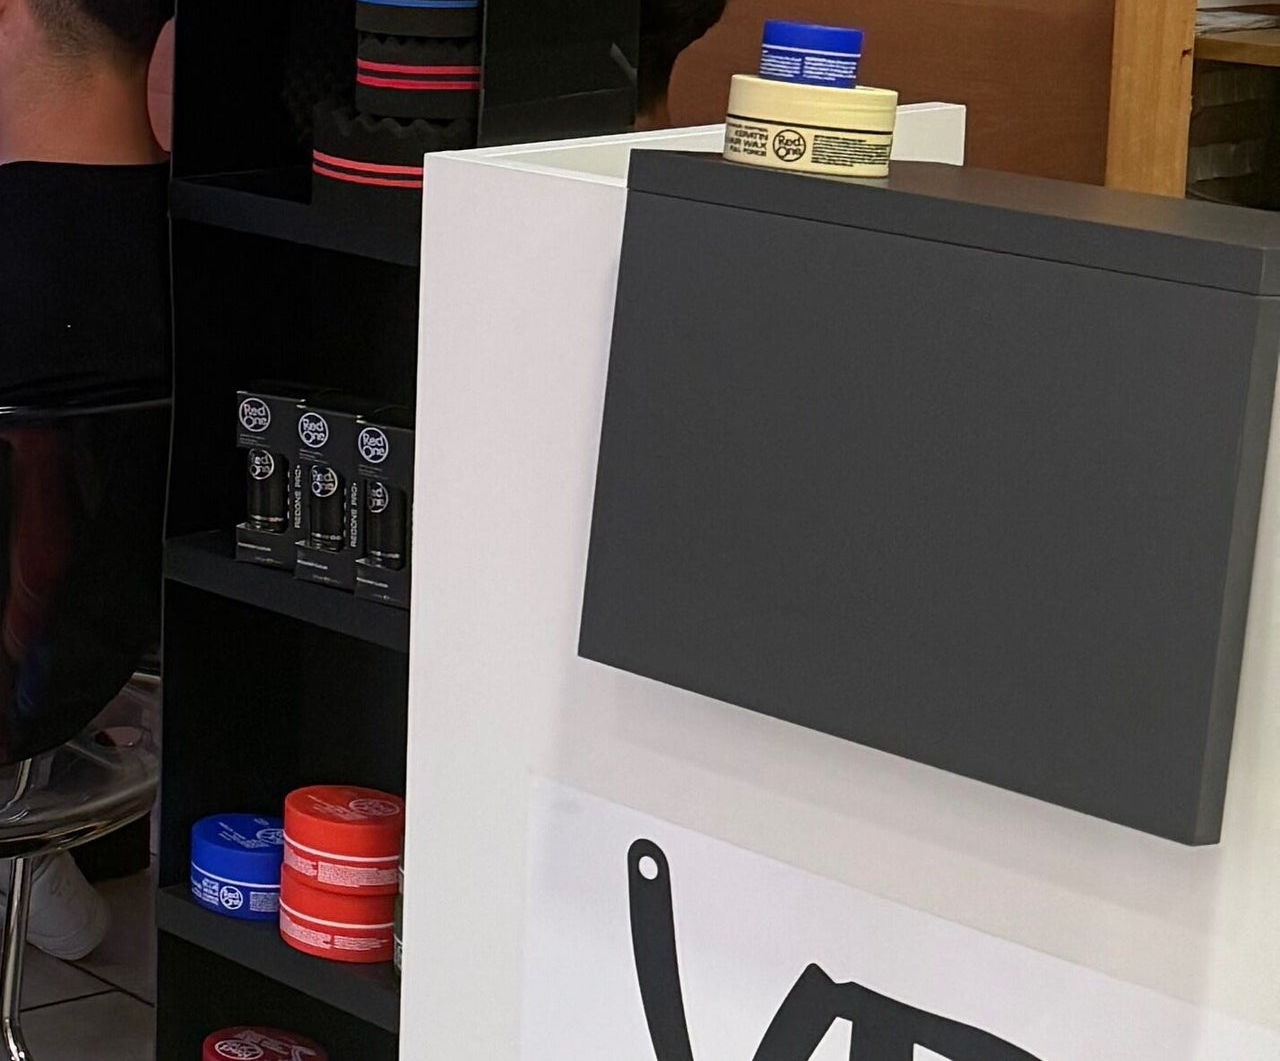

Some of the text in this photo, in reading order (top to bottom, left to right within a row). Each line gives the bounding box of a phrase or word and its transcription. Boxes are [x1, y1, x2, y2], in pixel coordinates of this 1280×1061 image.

[778, 134, 802, 148] Red
[776, 146, 802, 160] One
[243, 403, 266, 417] Red
[243, 415, 268, 428] One
[302, 418, 325, 432] Red
[302, 430, 326, 443] One
[362, 433, 384, 447] Red
[362, 445, 385, 458] One
